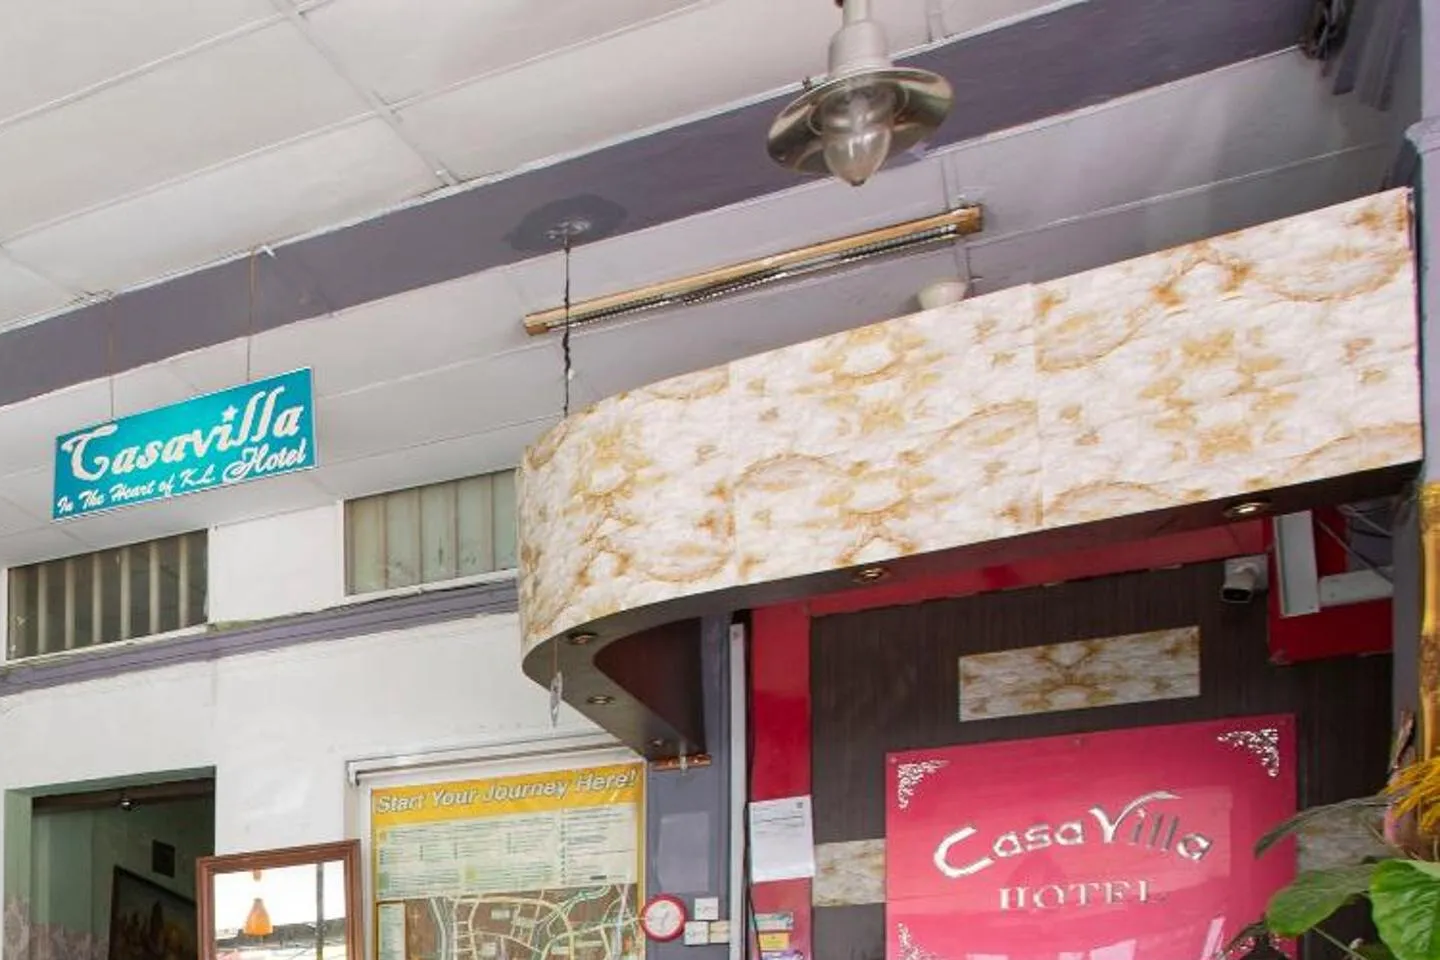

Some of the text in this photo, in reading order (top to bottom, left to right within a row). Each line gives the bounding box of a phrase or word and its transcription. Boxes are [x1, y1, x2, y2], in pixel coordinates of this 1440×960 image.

[60, 385, 304, 481] Casavilla
[79, 488, 105, 509] The
[110, 480, 155, 502] Heart
[158, 473, 176, 498] of
[222, 437, 307, 484] Hotel
[376, 768, 639, 814] Start Your Journey Here!
[999, 879, 1167, 912] HOTEL
